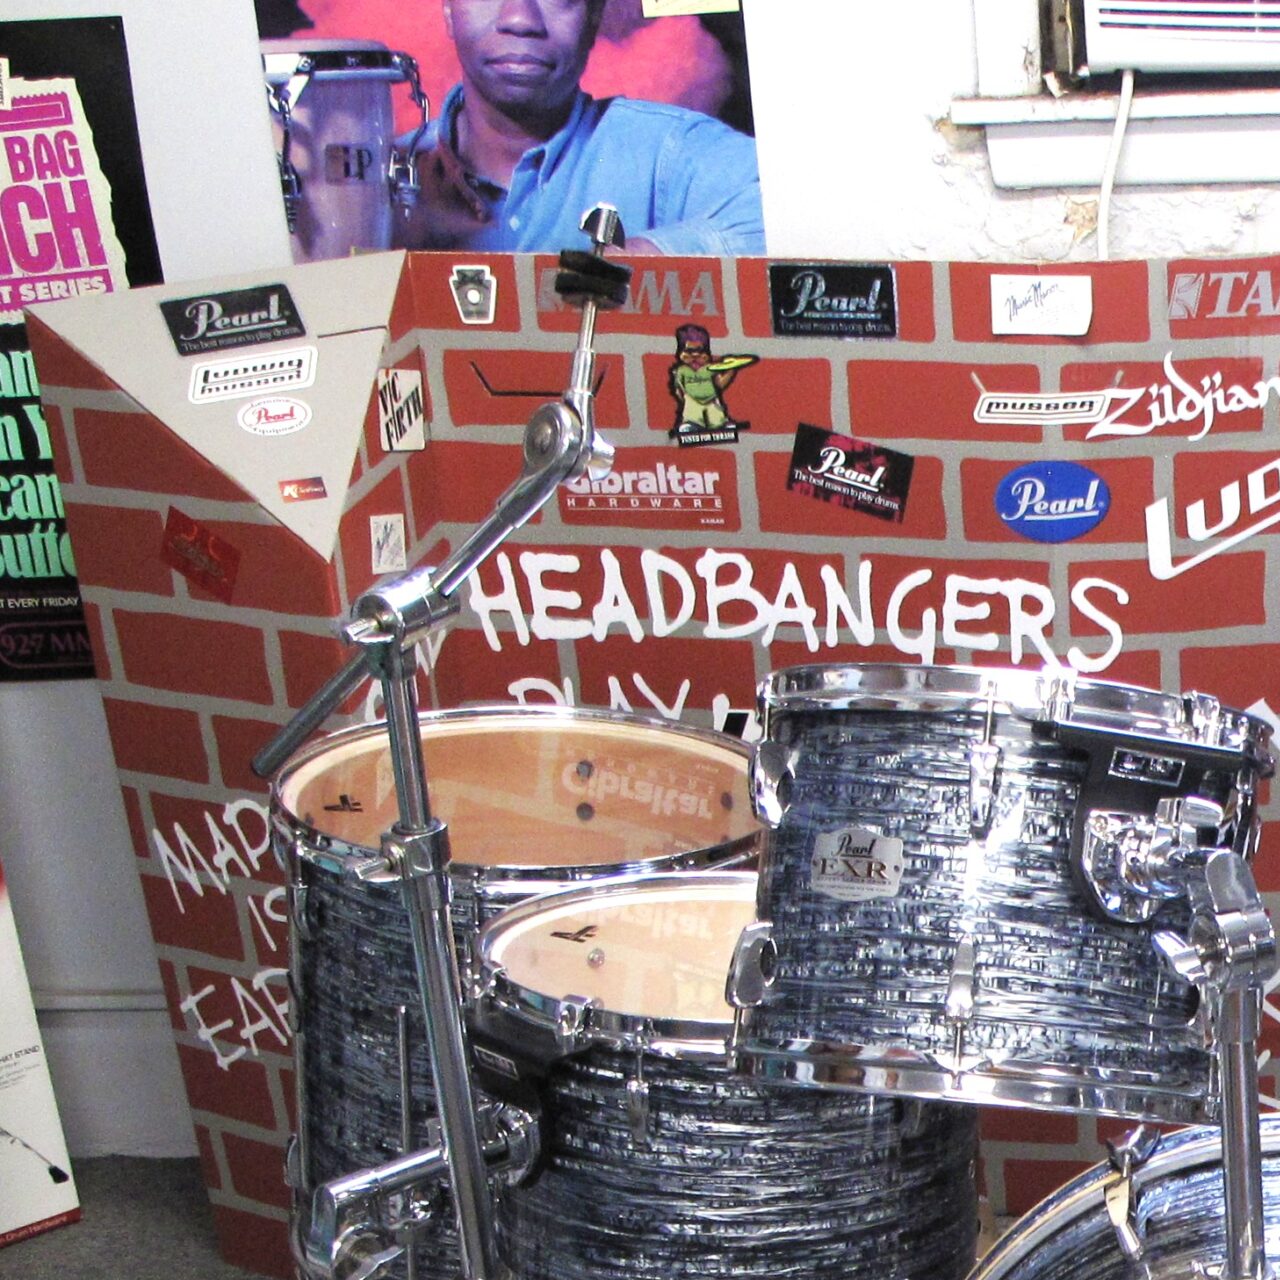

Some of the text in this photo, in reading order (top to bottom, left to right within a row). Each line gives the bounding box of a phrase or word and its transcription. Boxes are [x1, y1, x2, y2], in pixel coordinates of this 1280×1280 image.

[3, 130, 85, 183] BAG
[0, 179, 109, 275] CH
[20, 275, 107, 302] SERIES
[780, 269, 882, 318] Pearl
[180, 293, 282, 341] Pearl
[379, 372, 402, 416] VIC
[384, 386, 424, 451] FIRTH
[808, 446, 886, 488] Pearl
[567, 498, 723, 509] HARDWARE
[1001, 477, 1100, 520] Pearl
[7, 597, 40, 608] EVERY
[42, 596, 79, 607] FRIDAY
[469, 547, 1130, 673] HEADBANGERS
[832, 833, 877, 857] Pearl
